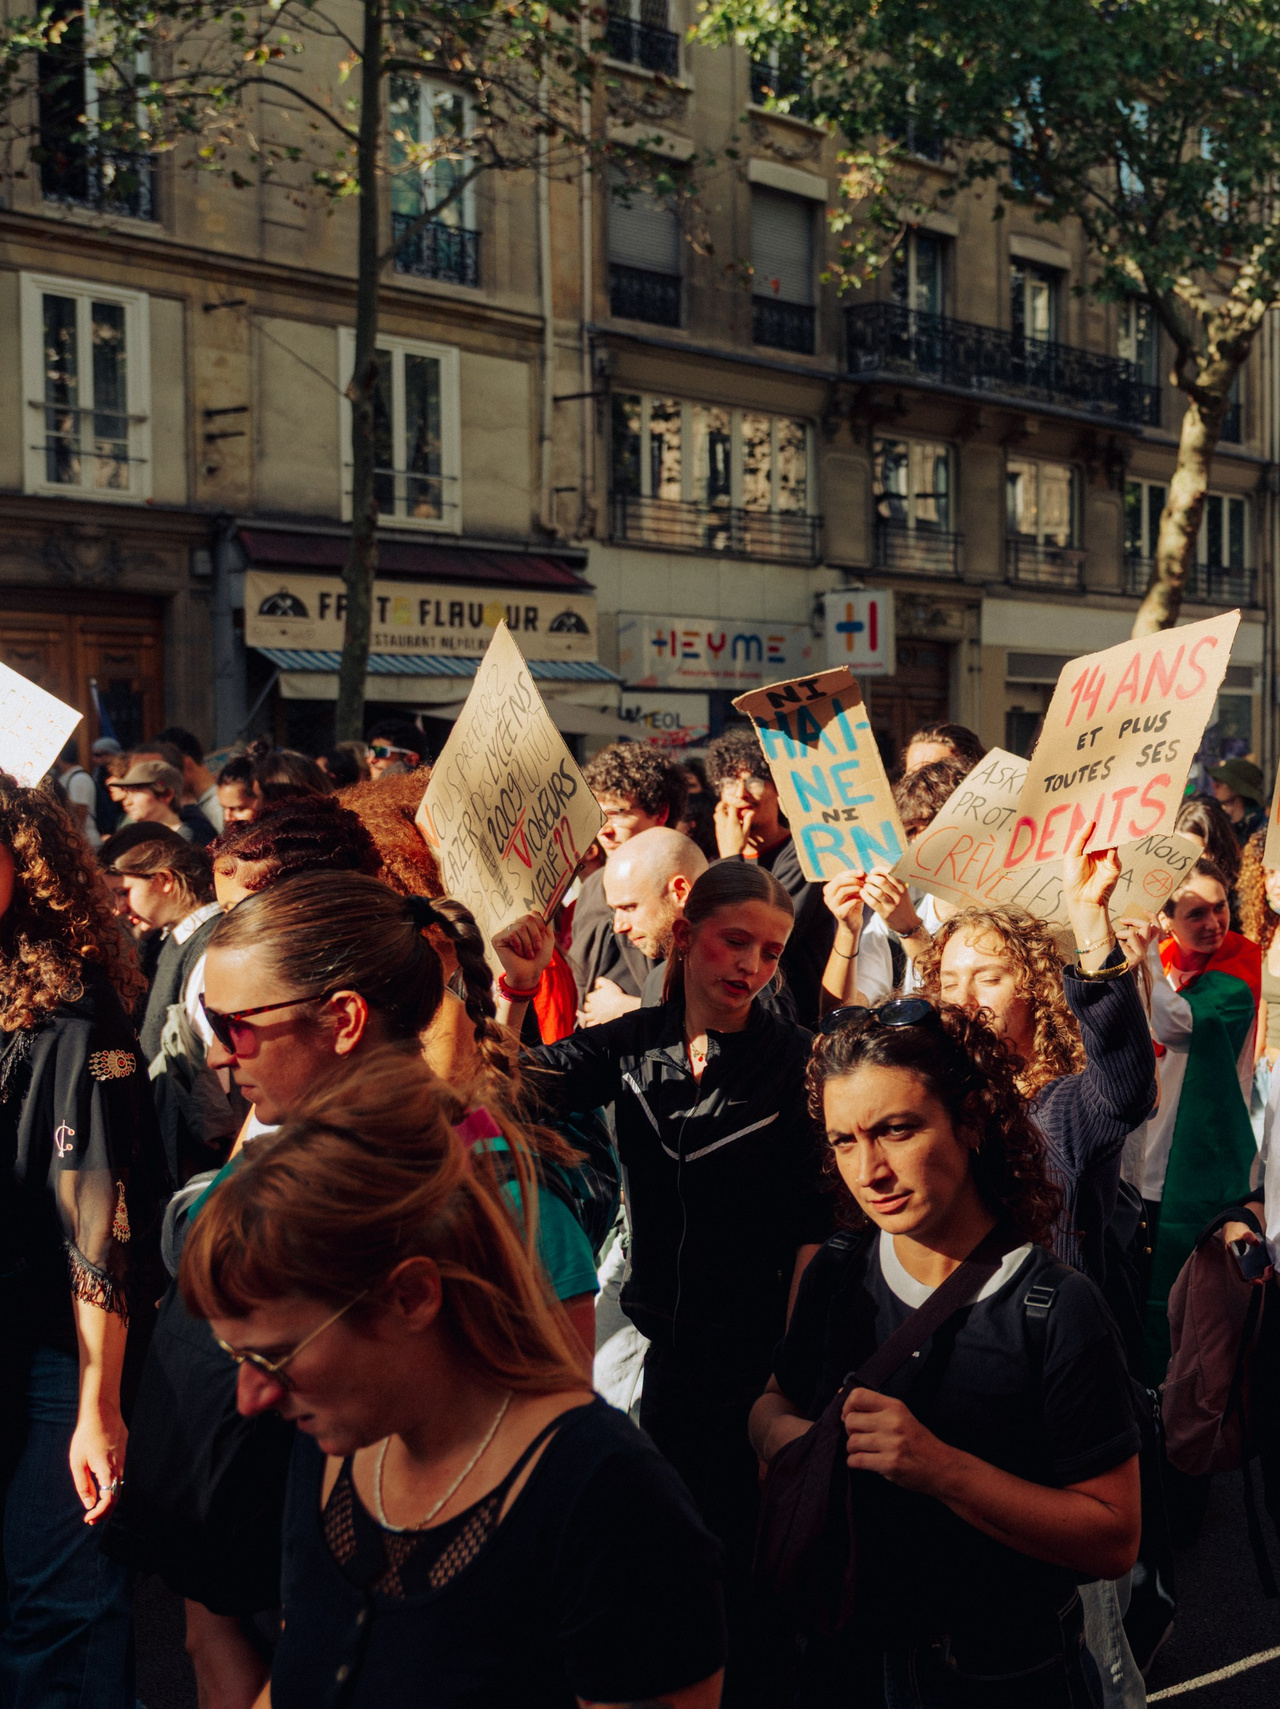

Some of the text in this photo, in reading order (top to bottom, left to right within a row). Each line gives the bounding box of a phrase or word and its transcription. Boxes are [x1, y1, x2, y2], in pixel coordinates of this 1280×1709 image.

[652, 629, 786, 664] HEYME
[765, 679, 827, 709] NI
[1065, 635, 1219, 727] 14 ANS
[754, 697, 870, 760] HAI-
[1076, 710, 1172, 751] ET PLUS
[790, 759, 875, 813] NE
[1043, 739, 1181, 793] TOUTES SES
[822, 808, 859, 824] NI
[1003, 773, 1172, 868] DENTS
[800, 820, 904, 878] RN
[1135, 835, 1193, 871] NOUS
